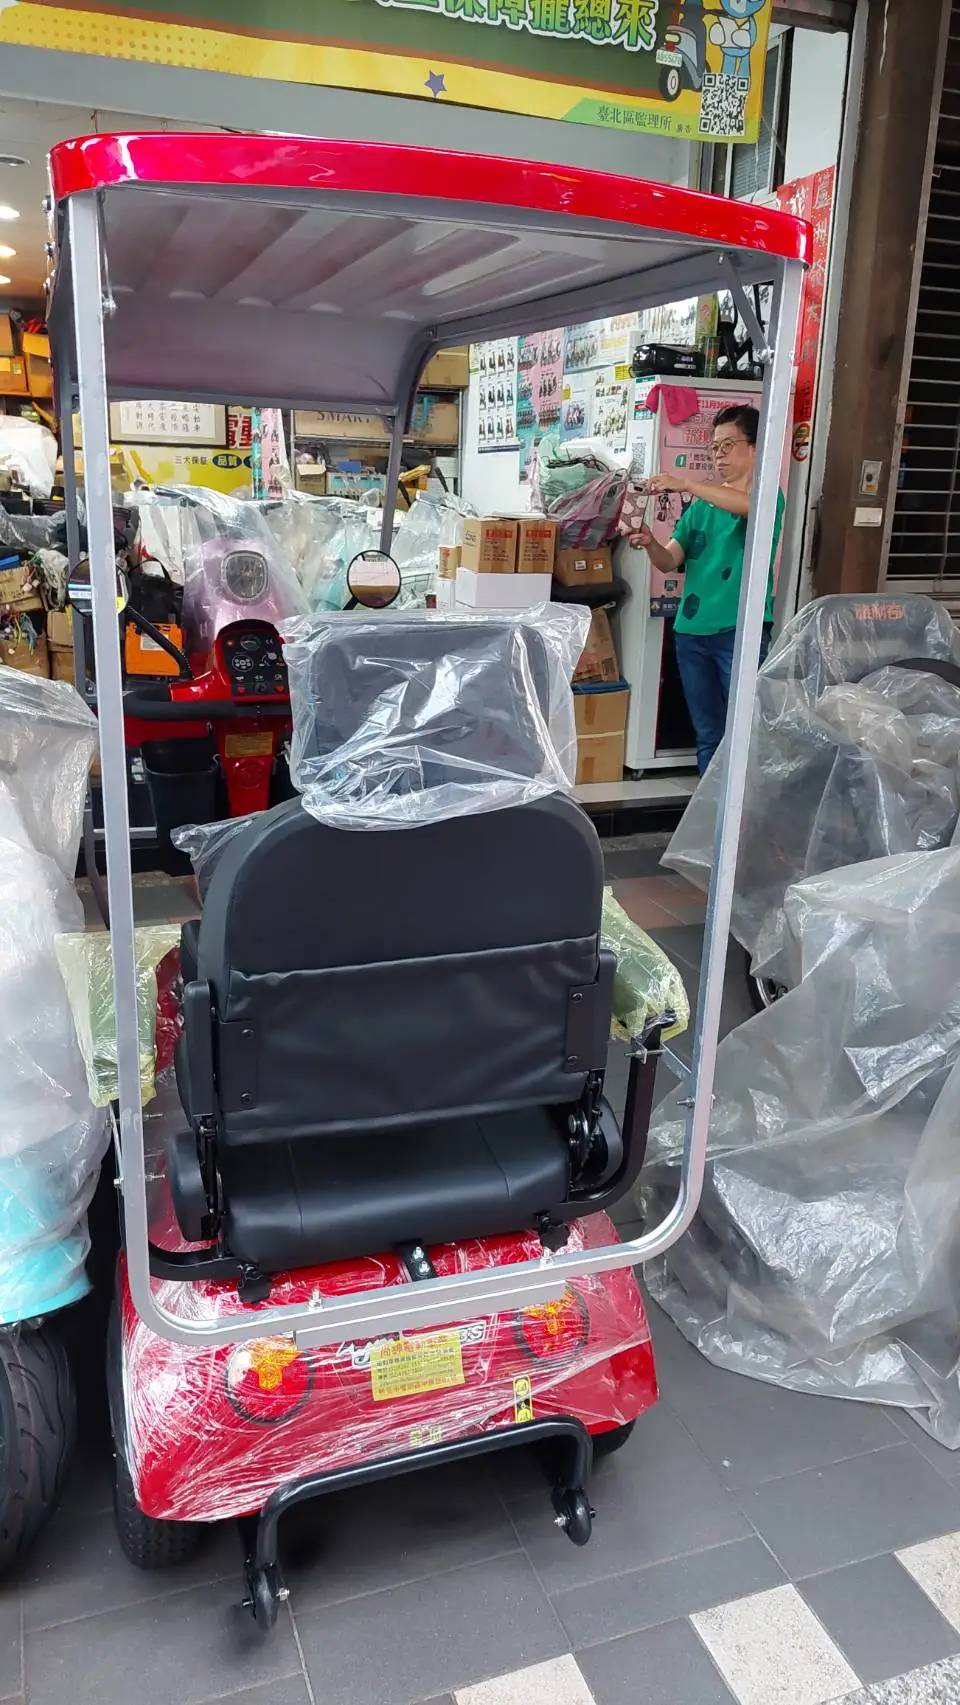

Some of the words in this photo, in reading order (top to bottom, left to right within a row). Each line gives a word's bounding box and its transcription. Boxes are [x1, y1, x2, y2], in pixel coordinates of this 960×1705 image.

[597, 104, 672, 131] 臺北區監理所
